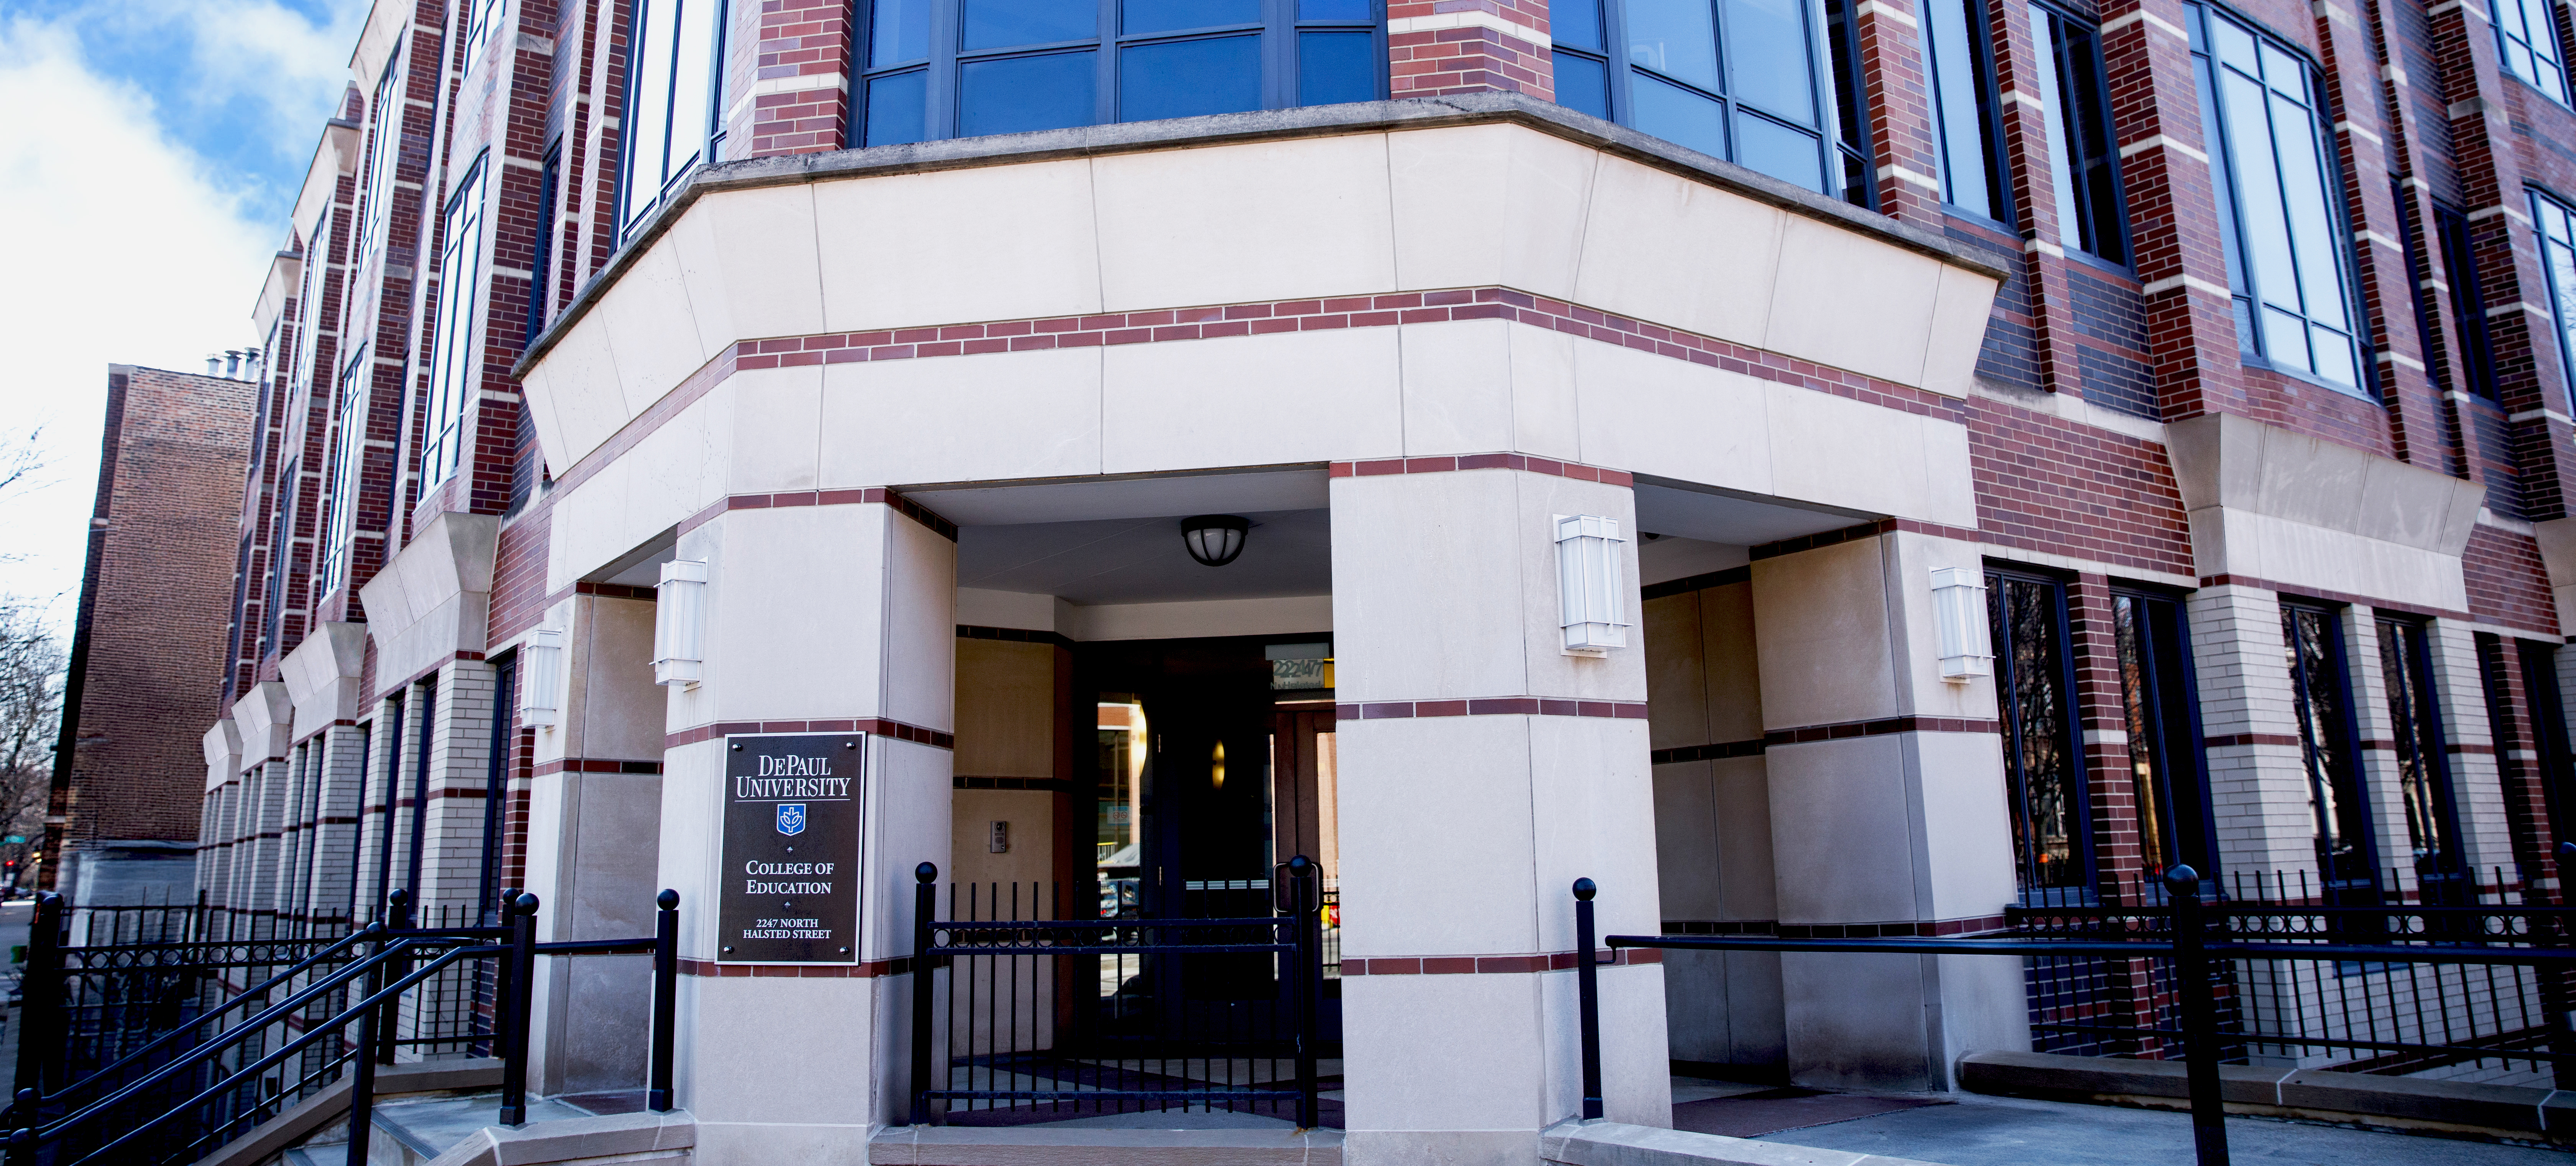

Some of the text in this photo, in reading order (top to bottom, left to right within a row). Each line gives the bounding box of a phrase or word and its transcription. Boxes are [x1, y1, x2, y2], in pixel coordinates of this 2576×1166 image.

[736, 776, 851, 798] UNIVERSITY
[746, 860, 834, 875] COLLEGE OF
[745, 880, 832, 894] EDUCATION
[756, 918, 818, 928] 2247 NORTH
[743, 929, 832, 939] HALSTED STREET
